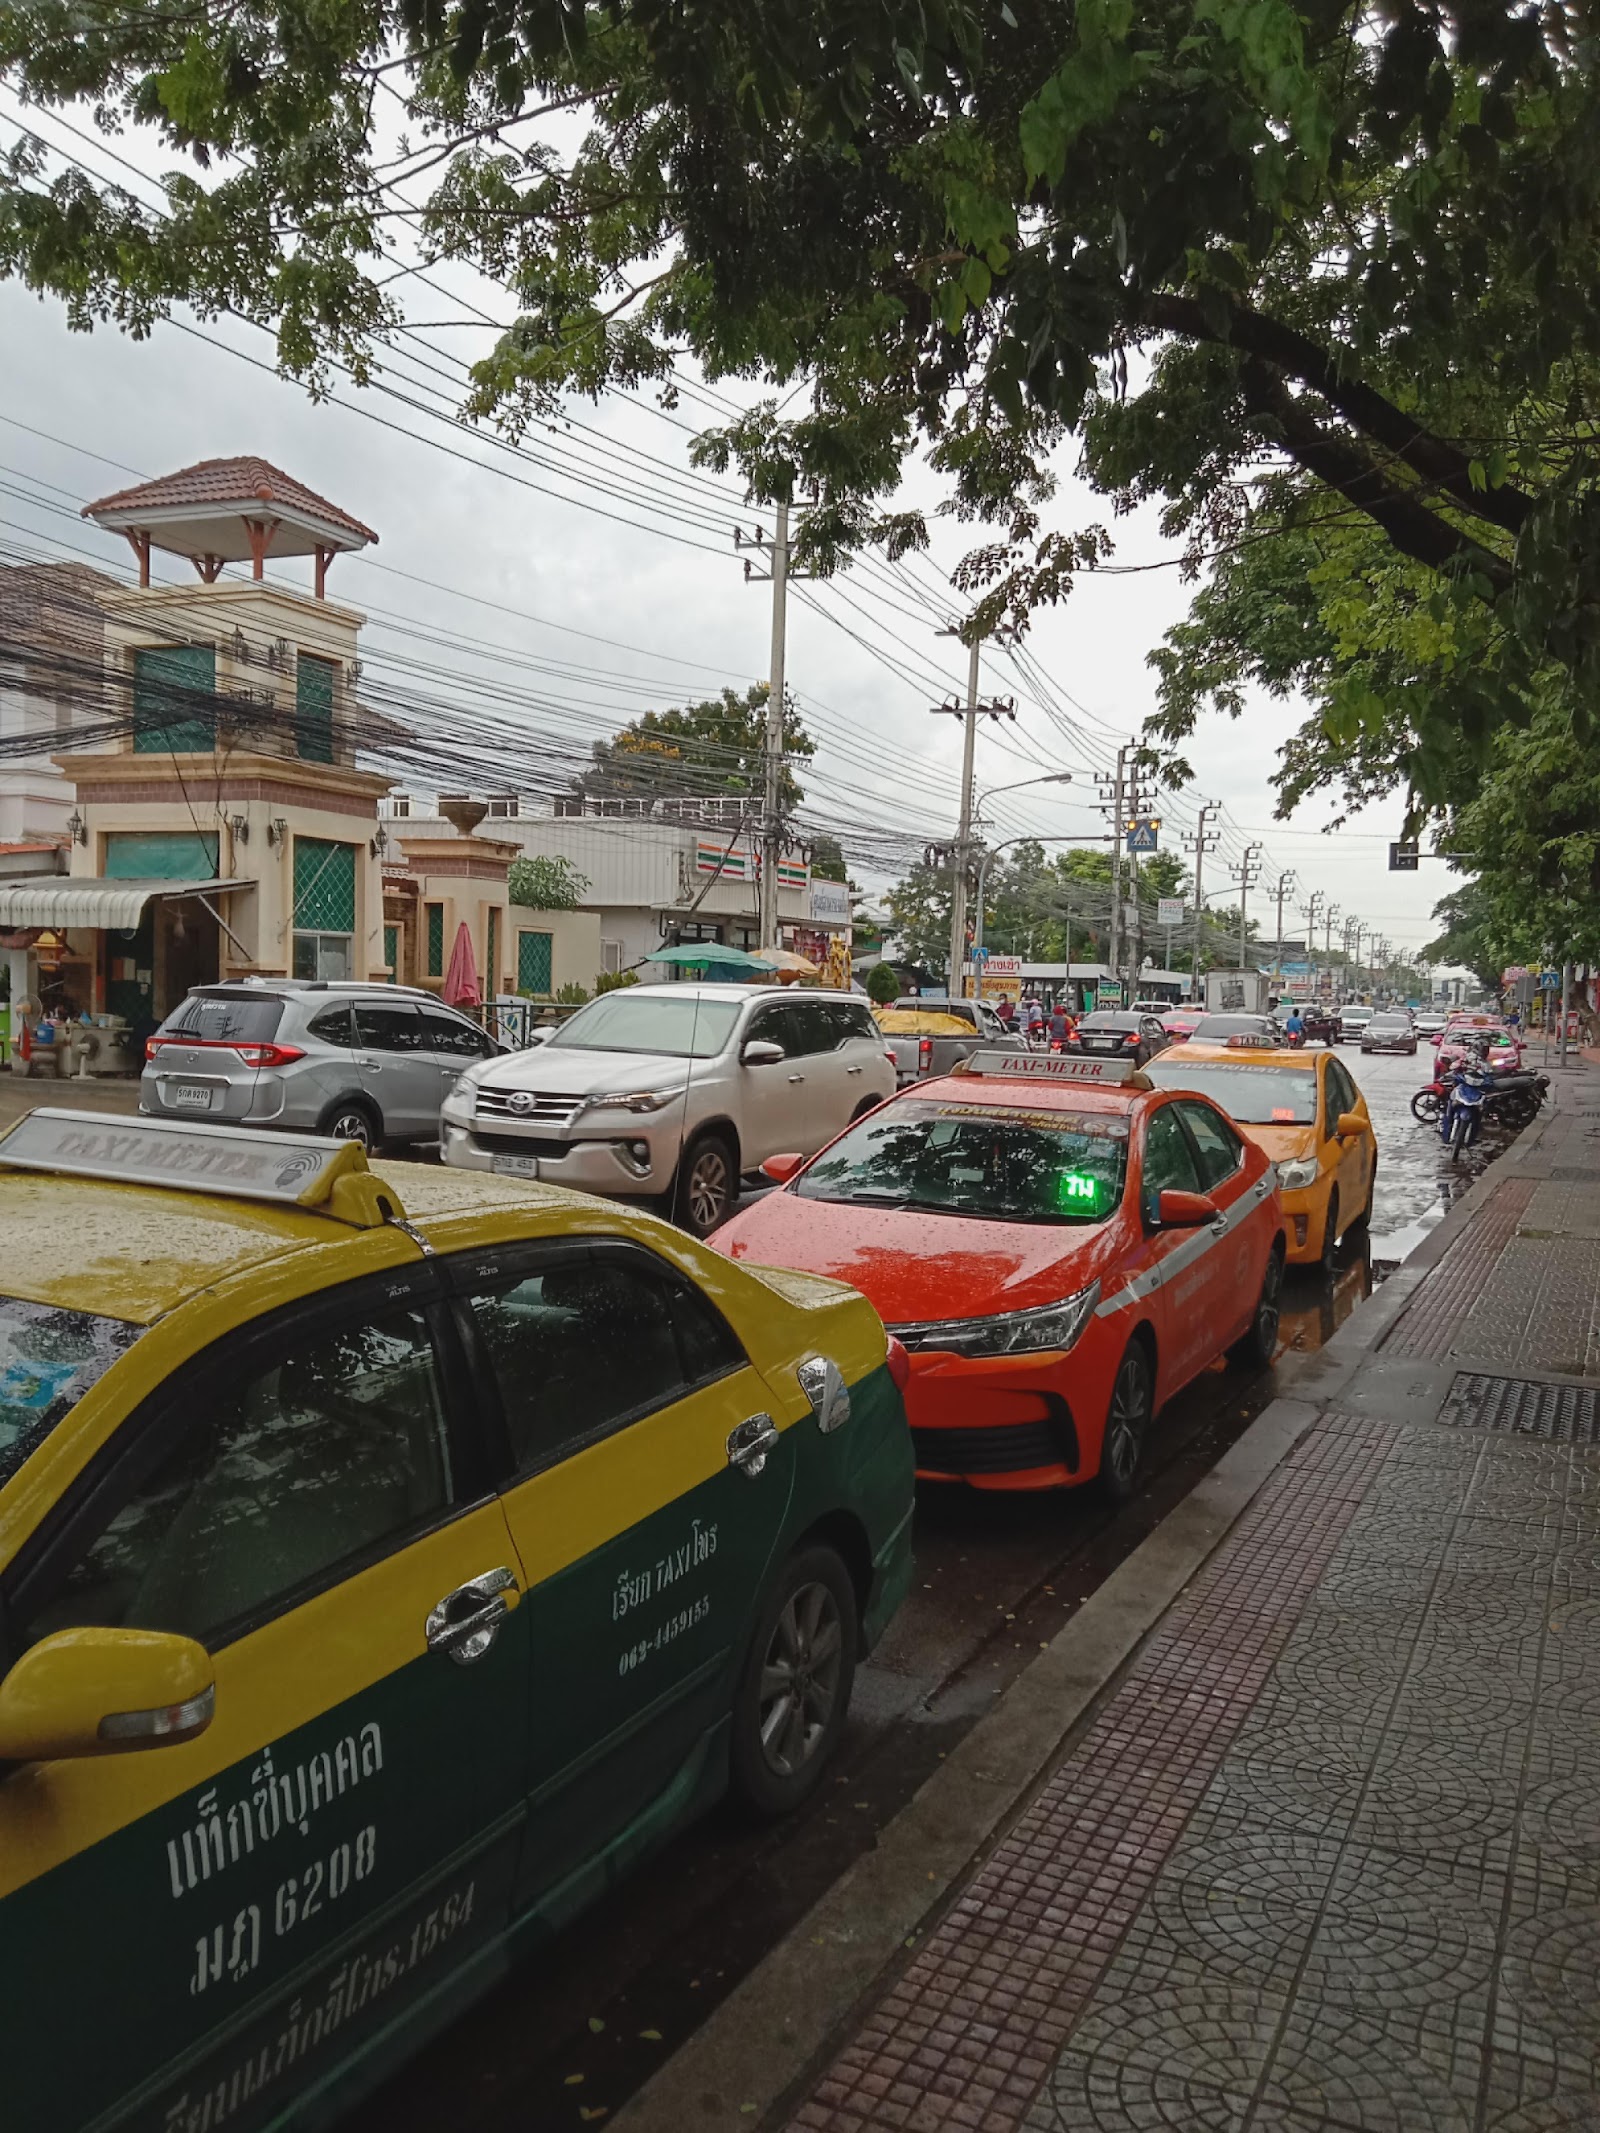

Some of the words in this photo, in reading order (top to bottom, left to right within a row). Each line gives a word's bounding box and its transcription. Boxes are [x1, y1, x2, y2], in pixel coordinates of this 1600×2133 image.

[983, 957, 1020, 971] ทางเข้า
[1239, 1036, 1261, 1047] TAXI
[1000, 1057, 1103, 1076] TAXI-METER
[54, 1132, 269, 1180] TAXI-METER
[479, 1266, 499, 1277] ALTIS
[388, 1285, 411, 1298] ALTIS
[612, 1569, 651, 1621] เรียก
[655, 1542, 691, 1592] TAXI
[166, 1721, 384, 1899] แท็กซี่บุคคล
[274, 1824, 376, 1937] 6208
